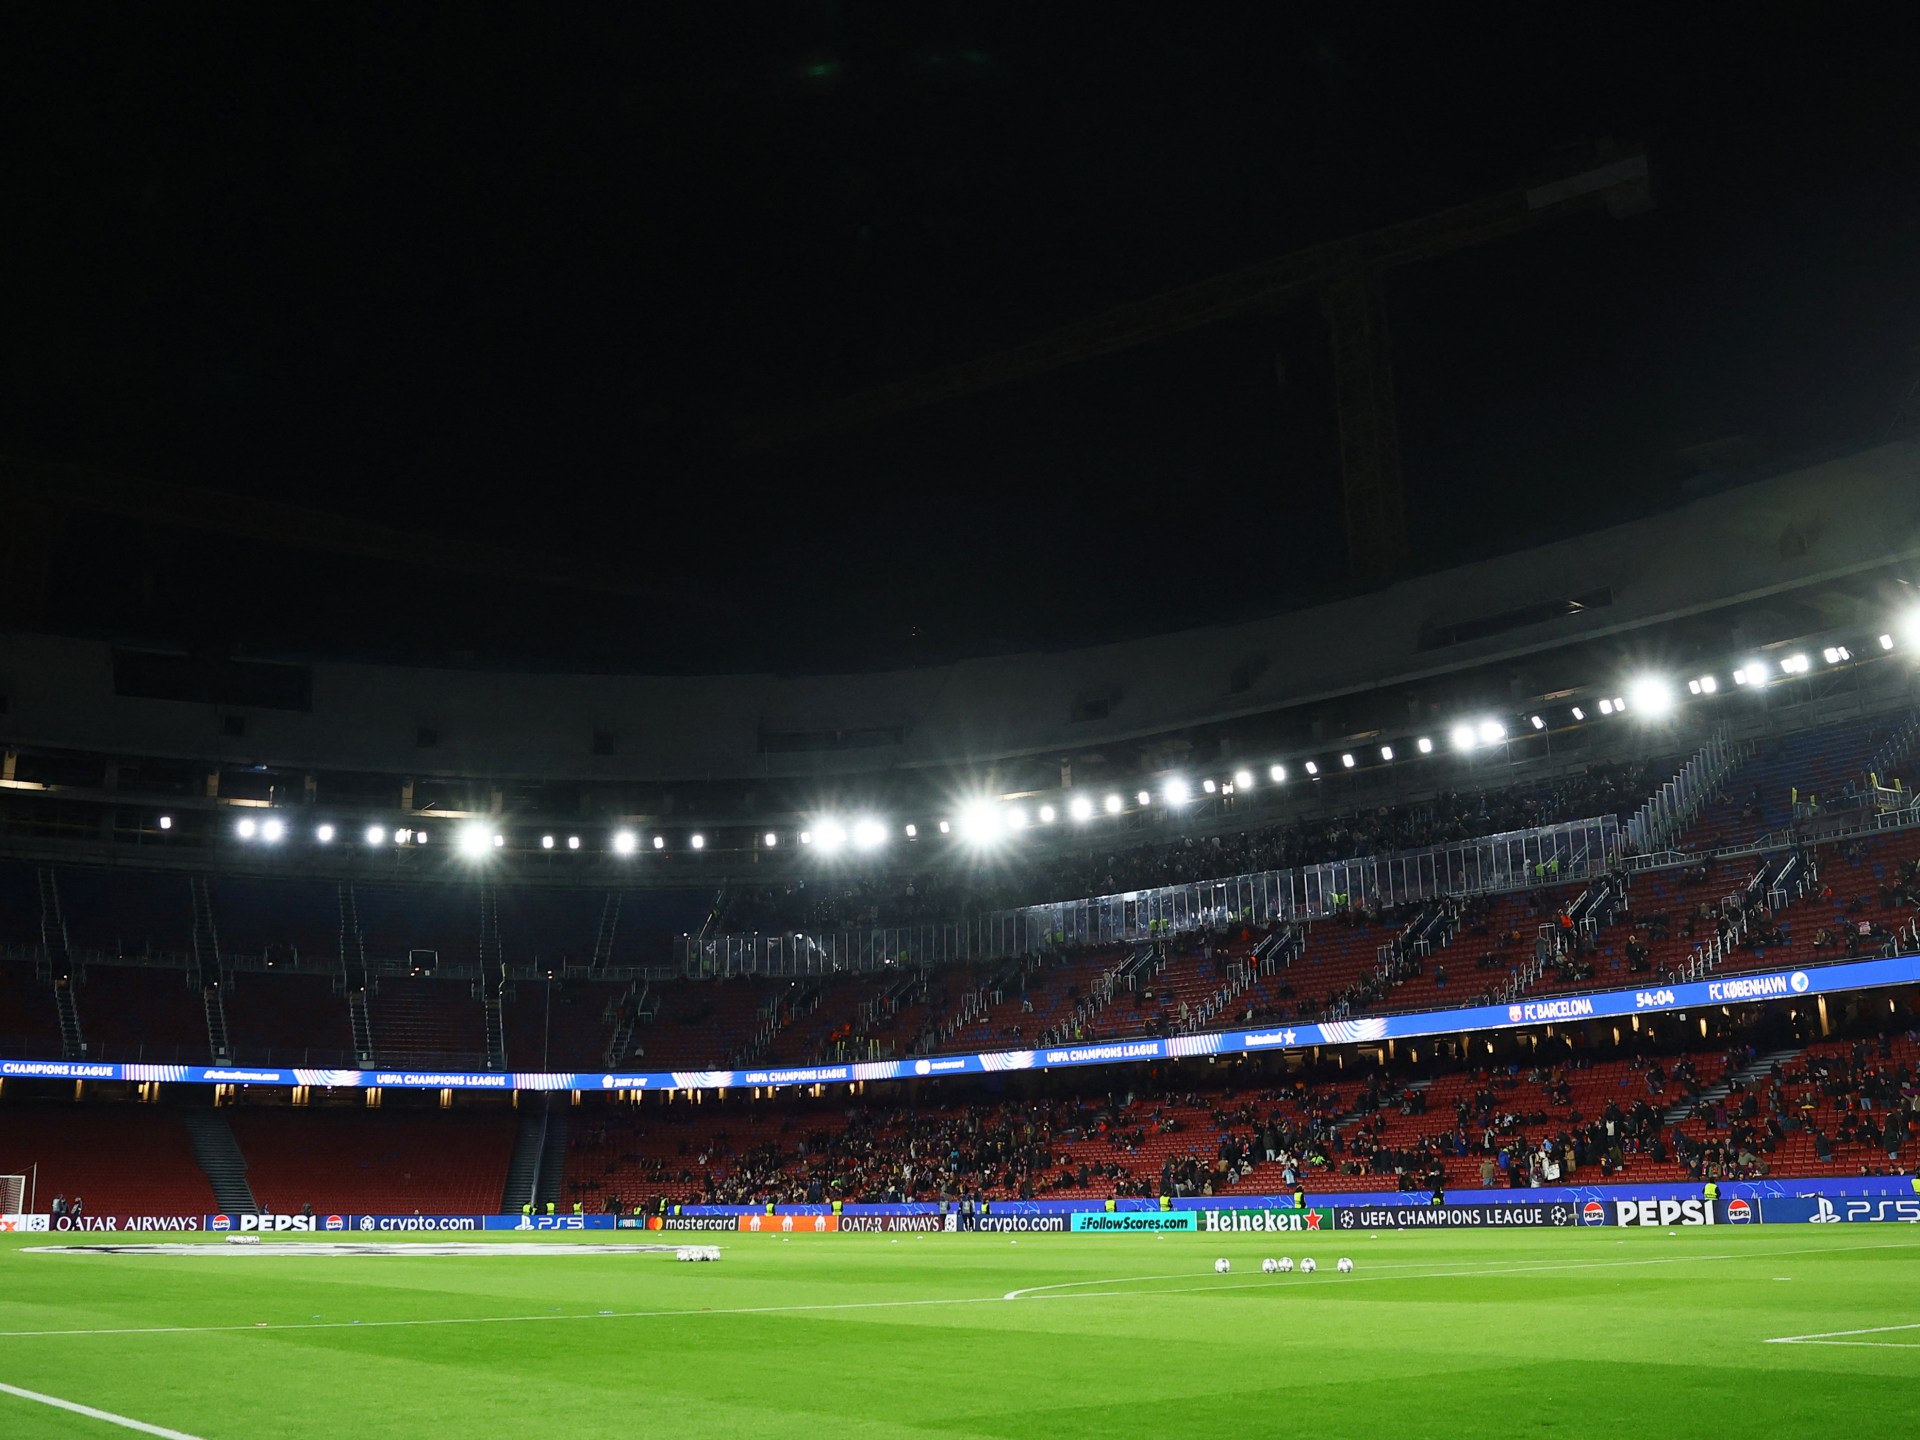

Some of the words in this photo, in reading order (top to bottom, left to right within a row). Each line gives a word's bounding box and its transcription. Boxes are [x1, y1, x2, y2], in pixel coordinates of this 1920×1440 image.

[1708, 984, 1723, 1000] FC
[1722, 976, 1788, 999] KØBENHAVN
[1636, 990, 1675, 1008] 54:04
[1524, 1005, 1537, 1020] FC
[1537, 999, 1593, 1019] BARCELONA
[1046, 1052, 1070, 1063] UEFA
[1070, 1048, 1122, 1061] CHAMPIONS
[1123, 1043, 1159, 1056] LEAGUE
[3, 1063, 70, 1075] CHAMPIONS
[70, 1065, 114, 1077] LEAGUE
[745, 1073, 769, 1083] UEFA
[769, 1069, 817, 1082] CHAMPIONS
[817, 1068, 847, 1079] LEAGUE
[376, 1074, 403, 1084] UEFA
[403, 1074, 465, 1085] CHAMPIONS
[465, 1075, 505, 1086] LEAGUE
[1360, 1211, 1396, 1226] UEFA
[1397, 1209, 1481, 1226] CHAMPIONS
[1486, 1208, 1544, 1225] LEAGUE
[1616, 1199, 1715, 1227] PEPSI
[1846, 1200, 1920, 1222] PS5
[123, 1216, 198, 1231] AIRWAYS
[240, 1214, 317, 1231] PEPSI
[380, 1215, 475, 1231] crypto.com
[538, 1217, 582, 1230] PS5
[665, 1217, 736, 1231] mastercard
[887, 1216, 940, 1232] AIRWAYS
[980, 1215, 1063, 1232] crypto.com
[1205, 1209, 1303, 1232] Heineken
